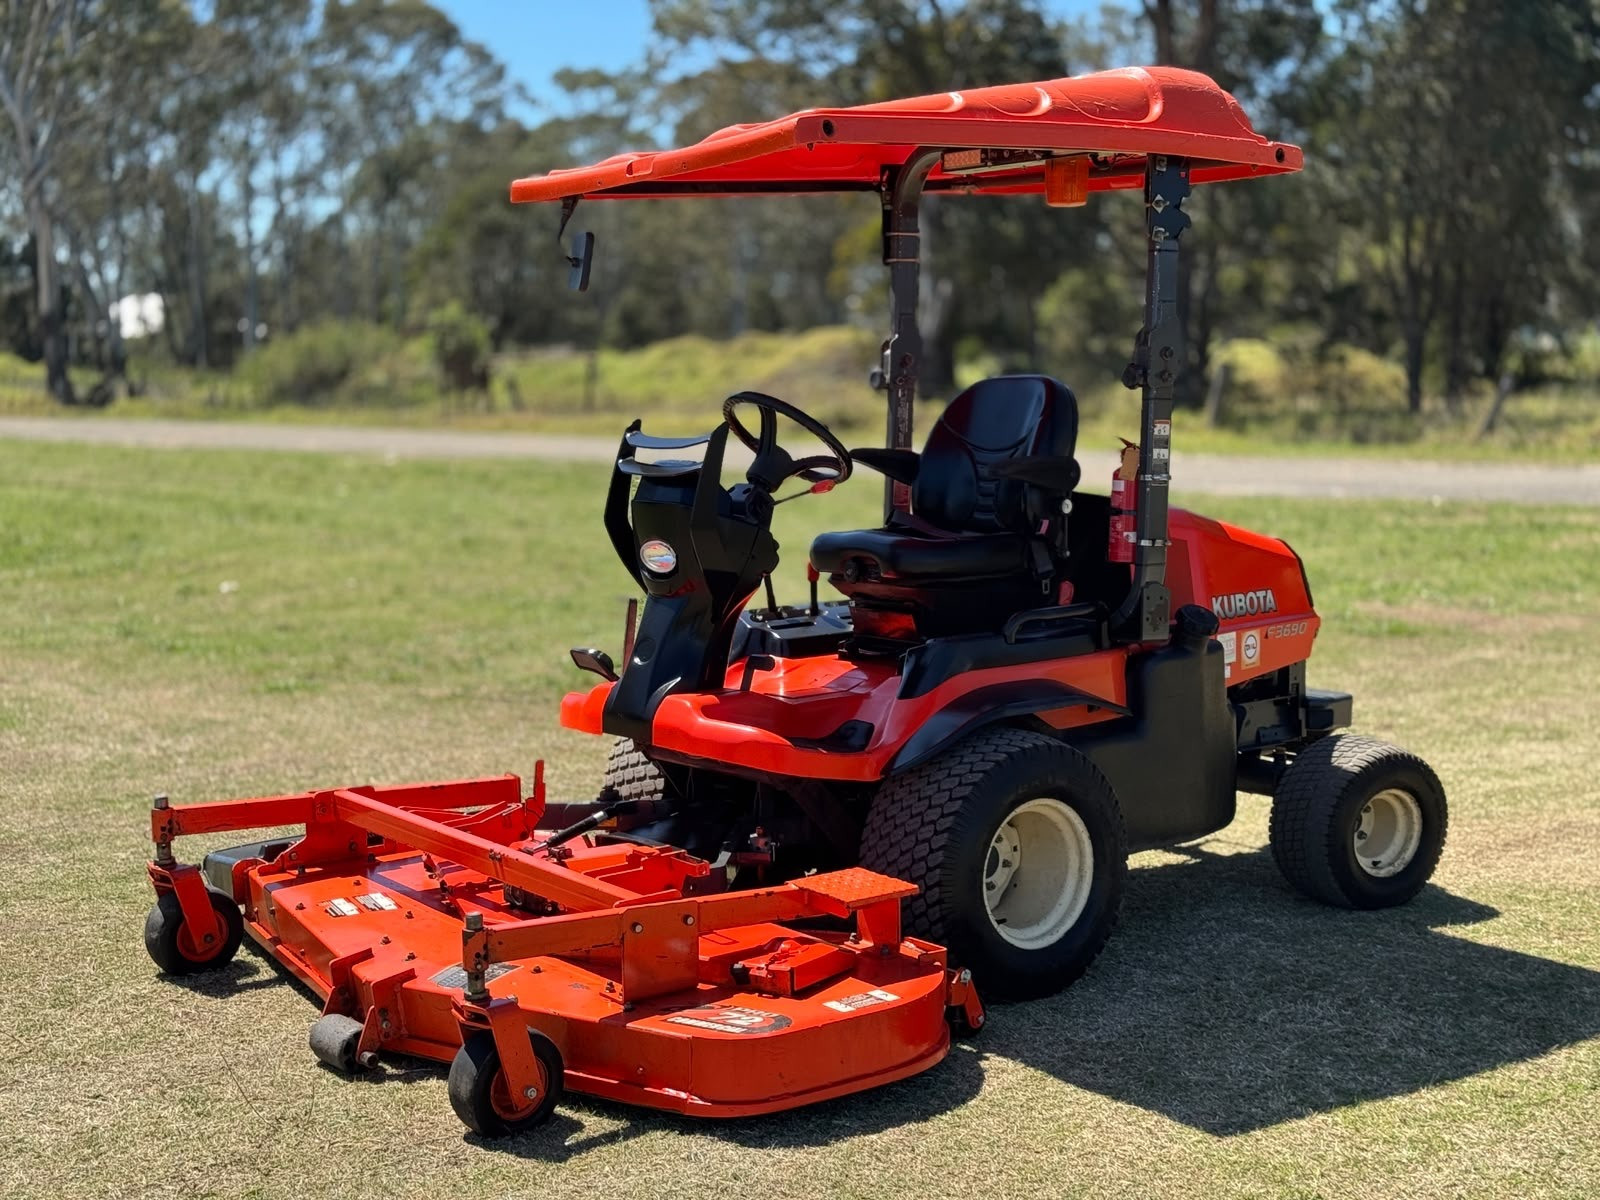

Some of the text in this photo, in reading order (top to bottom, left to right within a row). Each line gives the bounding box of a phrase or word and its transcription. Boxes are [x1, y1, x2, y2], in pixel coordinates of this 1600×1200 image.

[1212, 589, 1277, 619] KUBOTA
[1267, 622, 1308, 638] F3690
[706, 1011, 764, 1026] 72
